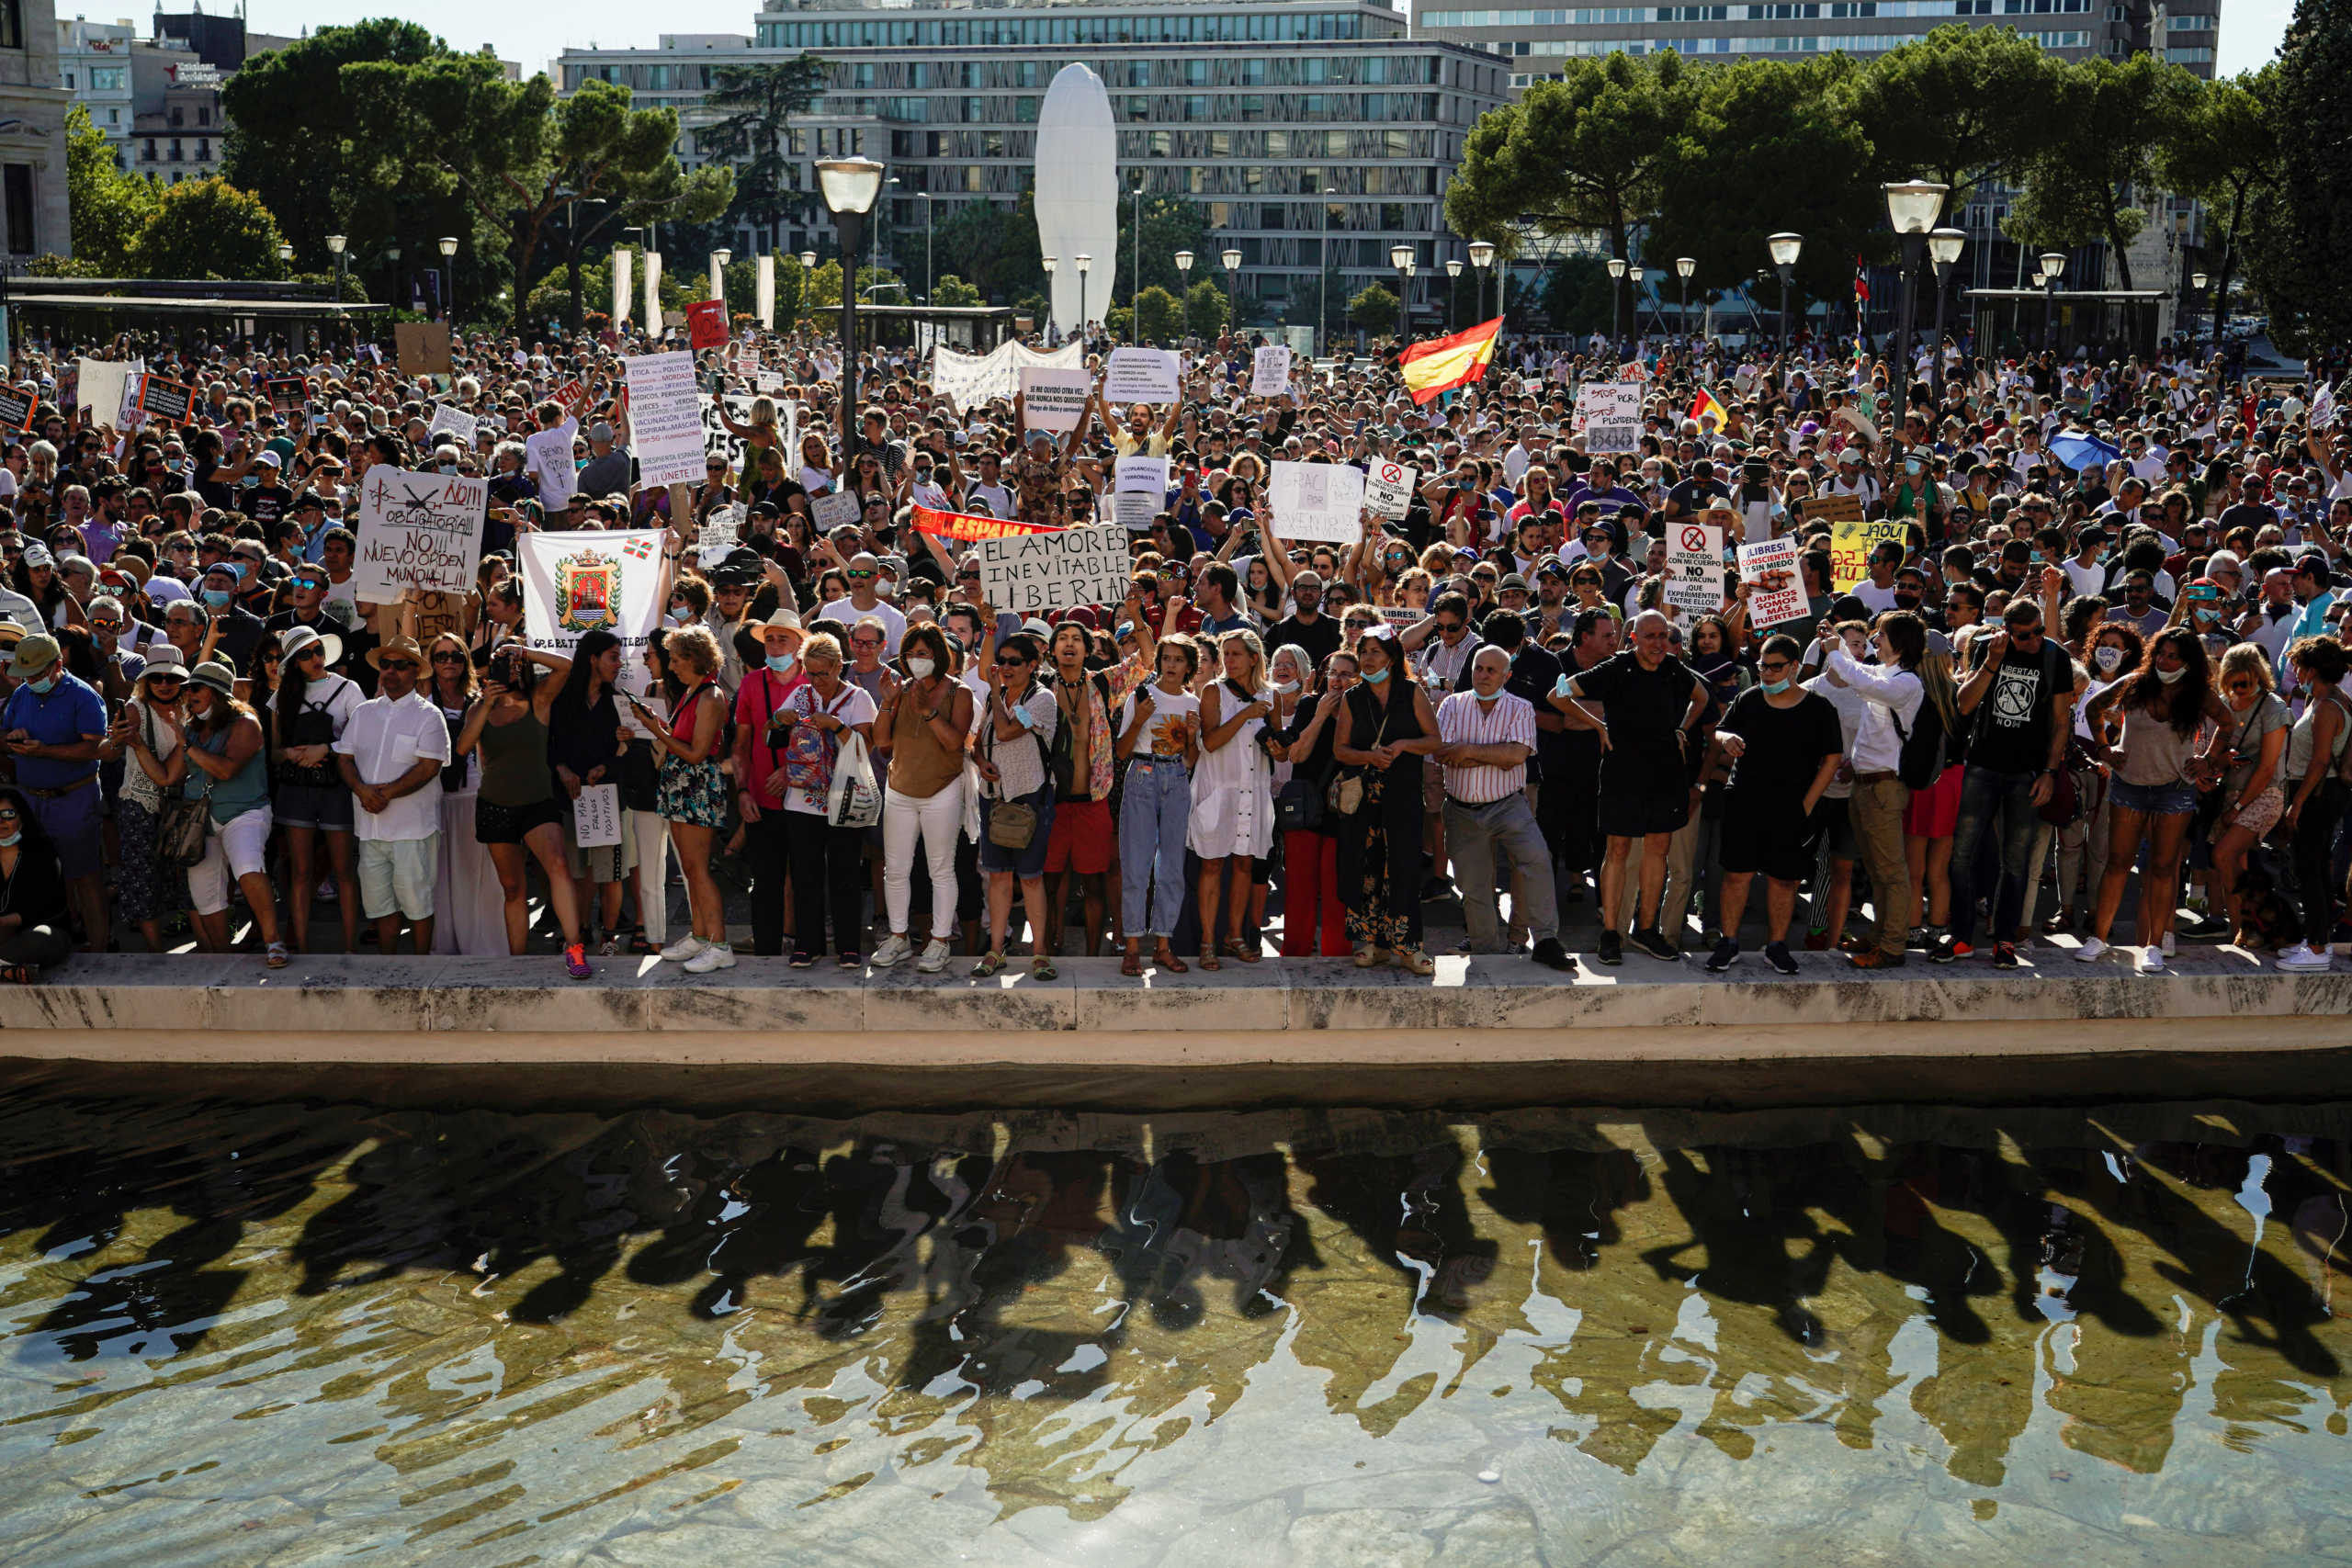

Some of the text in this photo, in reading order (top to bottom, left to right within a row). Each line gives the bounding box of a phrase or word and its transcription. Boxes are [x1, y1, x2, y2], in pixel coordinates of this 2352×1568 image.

[1384, 480, 1405, 491] DECIDO
[1387, 487, 1410, 497] CUERPO
[1379, 491, 1394, 502] NO
[364, 538, 414, 565] NUEVO
[985, 540, 1010, 562] EL
[1686, 552, 1713, 560] DECIDO
[1747, 542, 1786, 558] ¡LIBRES!
[1682, 558, 1693, 566] MI
[1694, 558, 1721, 567] CUERPO
[1741, 551, 1795, 567] CONSCIENTES
[1751, 564, 1765, 572] SIN
[1766, 558, 1794, 570] MIEDO
[988, 555, 1126, 583] INEVITABLE
[1685, 566, 1703, 576] NO
[988, 576, 1132, 610] LIBERTAD
[1667, 591, 1721, 600] EXPERIMENTEN
[1755, 590, 1797, 604] JUNTOS
[1693, 598, 1717, 606] ELLOS!
[1757, 597, 1798, 611] SOMOS
[1755, 607, 1808, 626] FUERTES!!
[1766, 604, 1791, 615] MÁS
[1688, 615, 1702, 624] NO
[2001, 663, 2040, 677] LIBERTAD
[590, 798, 599, 830] FALSOS
[602, 788, 614, 837] POSITIVOS
[581, 824, 590, 840] NO
